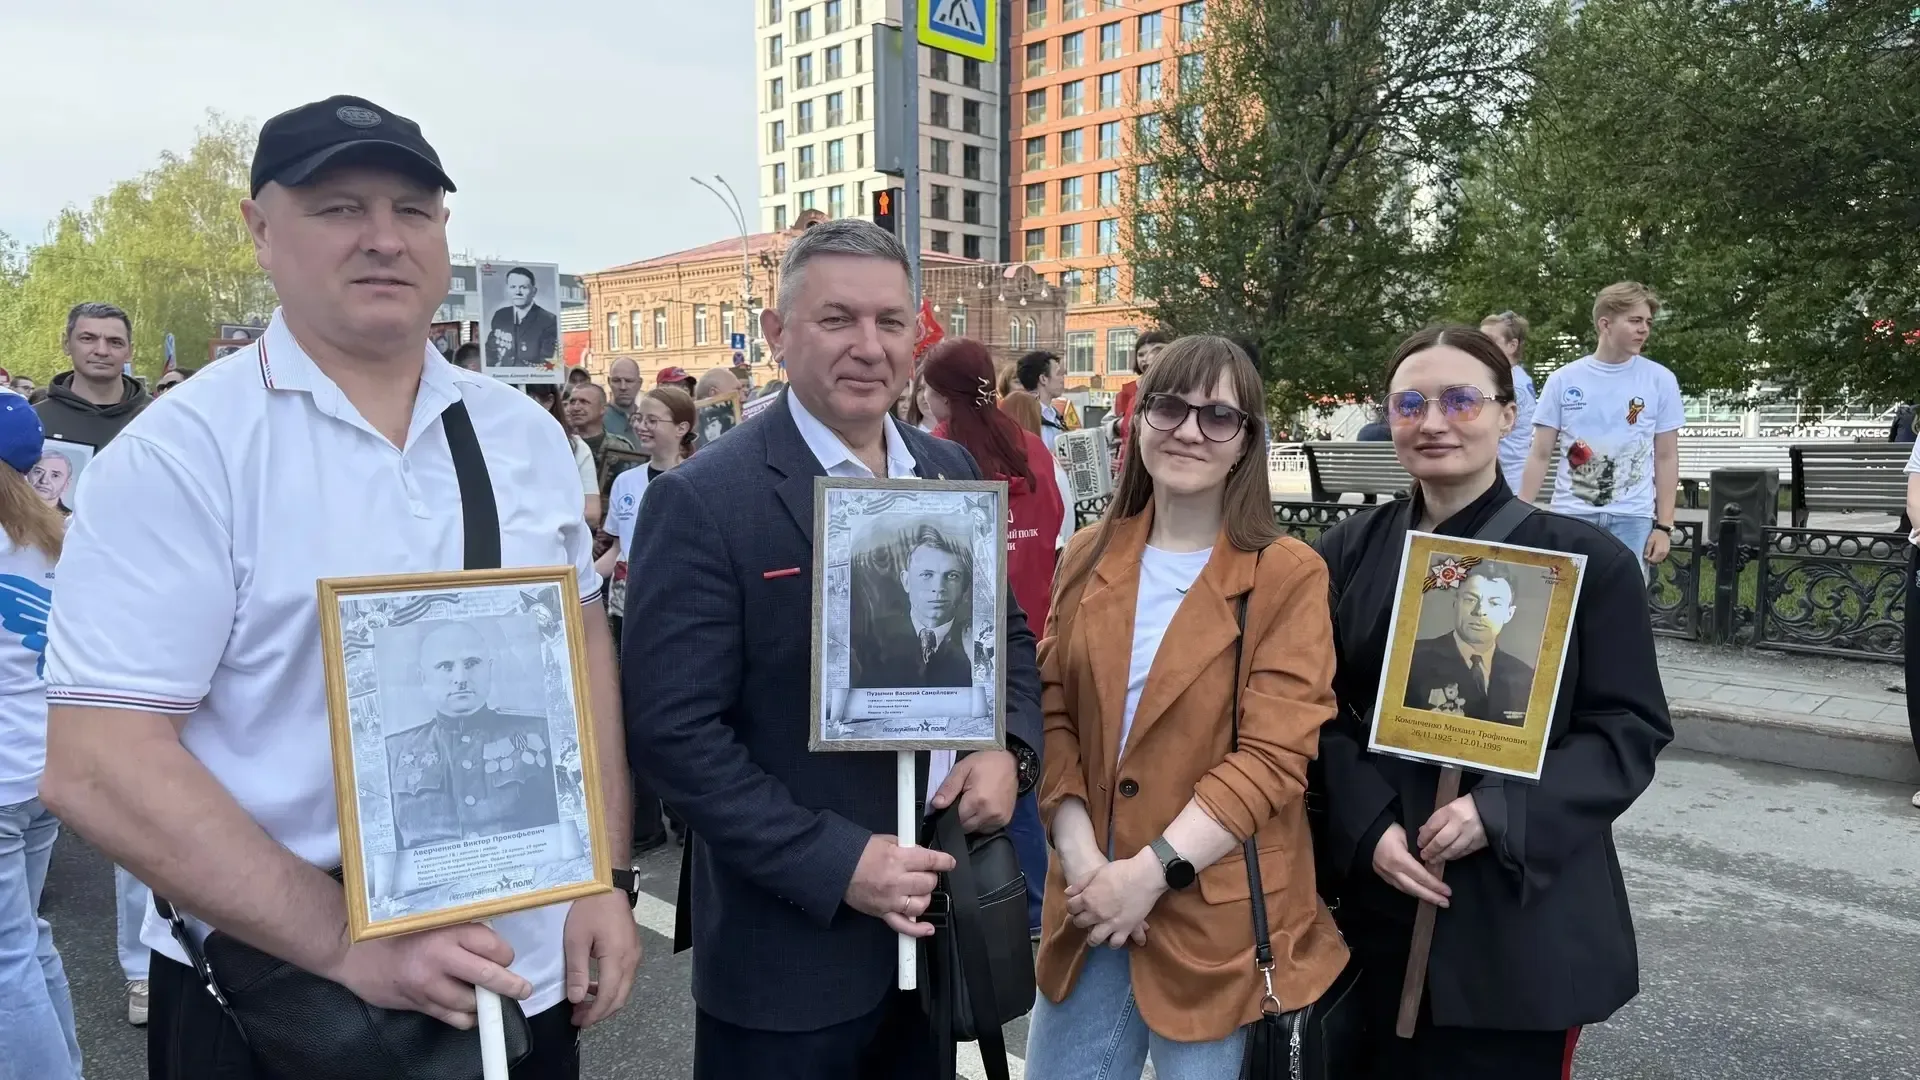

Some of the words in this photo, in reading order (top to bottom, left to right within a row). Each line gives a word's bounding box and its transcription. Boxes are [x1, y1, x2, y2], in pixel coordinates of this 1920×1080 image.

[1018, 528, 1038, 538] ПОЛК
[1444, 724, 1476, 736] Михаил
[1478, 730, 1528, 746] Трофимович
[1460, 736, 1502, 752] 12.01.1995
[412, 843, 461, 857] Аверченков
[463, 837, 491, 849] Виктор
[492, 828, 545, 844] Прокофьевич
